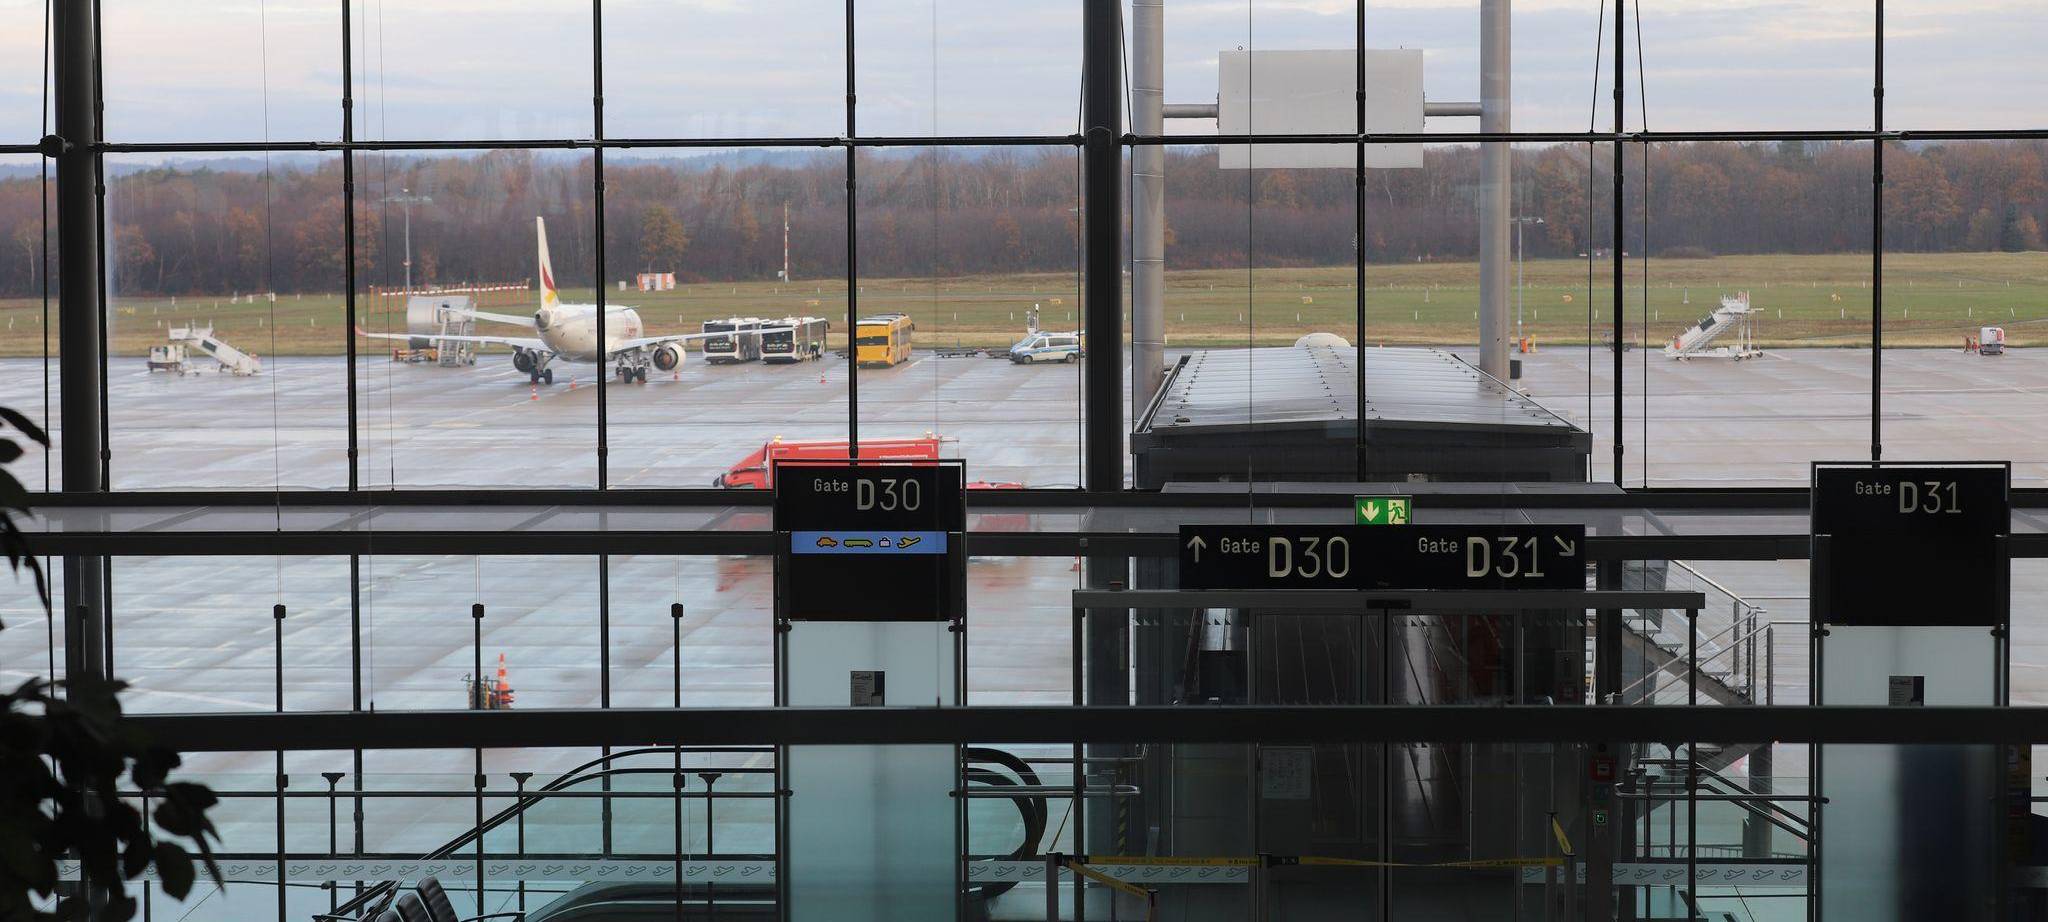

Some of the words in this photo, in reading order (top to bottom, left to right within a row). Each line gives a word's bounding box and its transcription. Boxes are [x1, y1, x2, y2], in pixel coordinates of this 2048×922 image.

[815, 479, 848, 492] Gate
[857, 479, 919, 510] D30
[1856, 481, 1890, 495] Gate
[1900, 482, 1962, 513] D31
[1221, 538, 1259, 553] Gate
[1270, 537, 1348, 577] D30
[1419, 538, 1457, 553] Gate
[1467, 537, 1545, 577] D31
